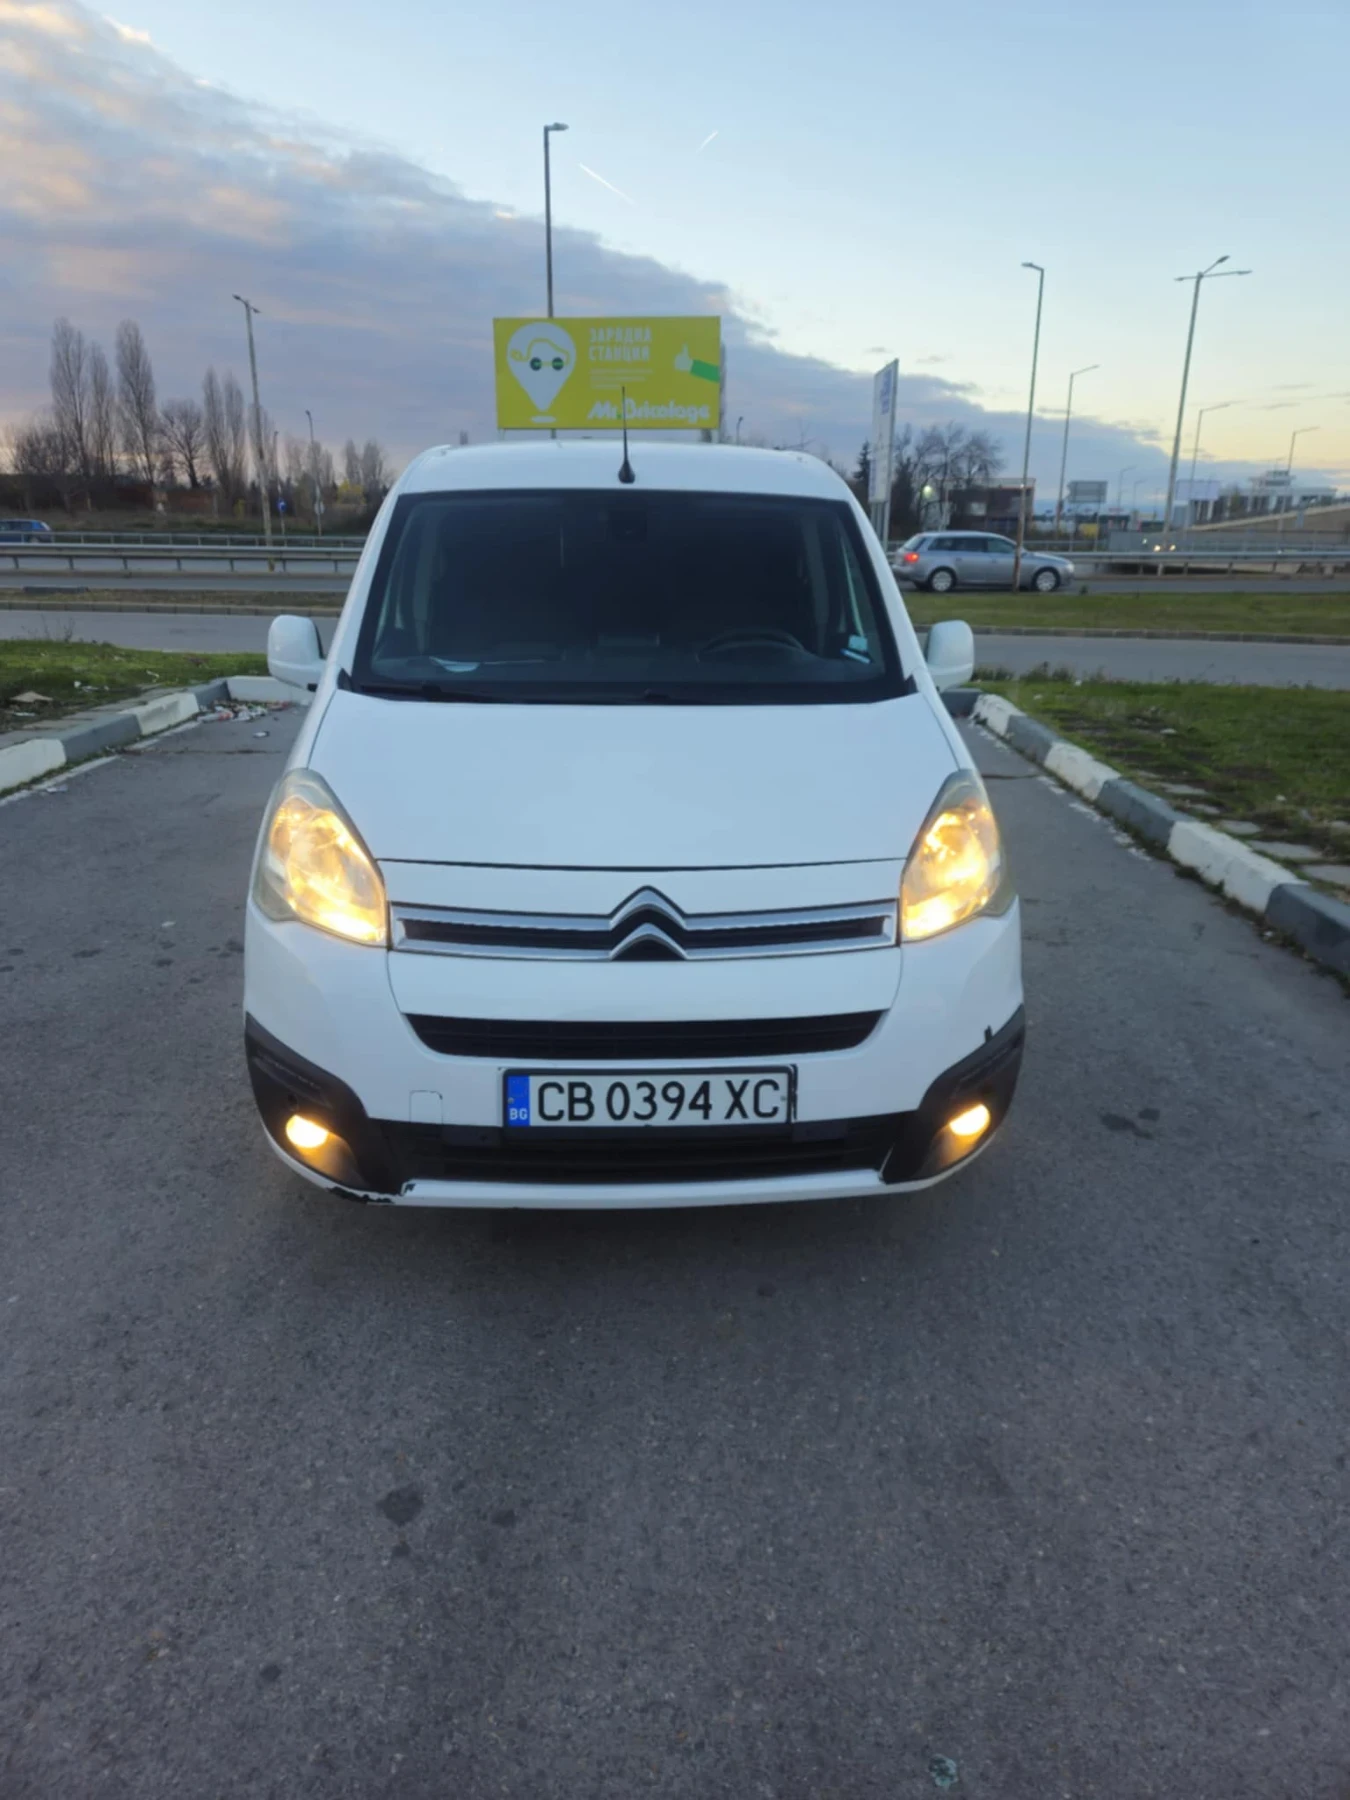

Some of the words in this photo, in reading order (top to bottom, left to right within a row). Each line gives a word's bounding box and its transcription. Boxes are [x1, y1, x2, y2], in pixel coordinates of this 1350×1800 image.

[538, 1082, 595, 1121] CB
[606, 1080, 712, 1121] 0394
[724, 1079, 780, 1119] XC
[509, 1108, 528, 1120] BG
